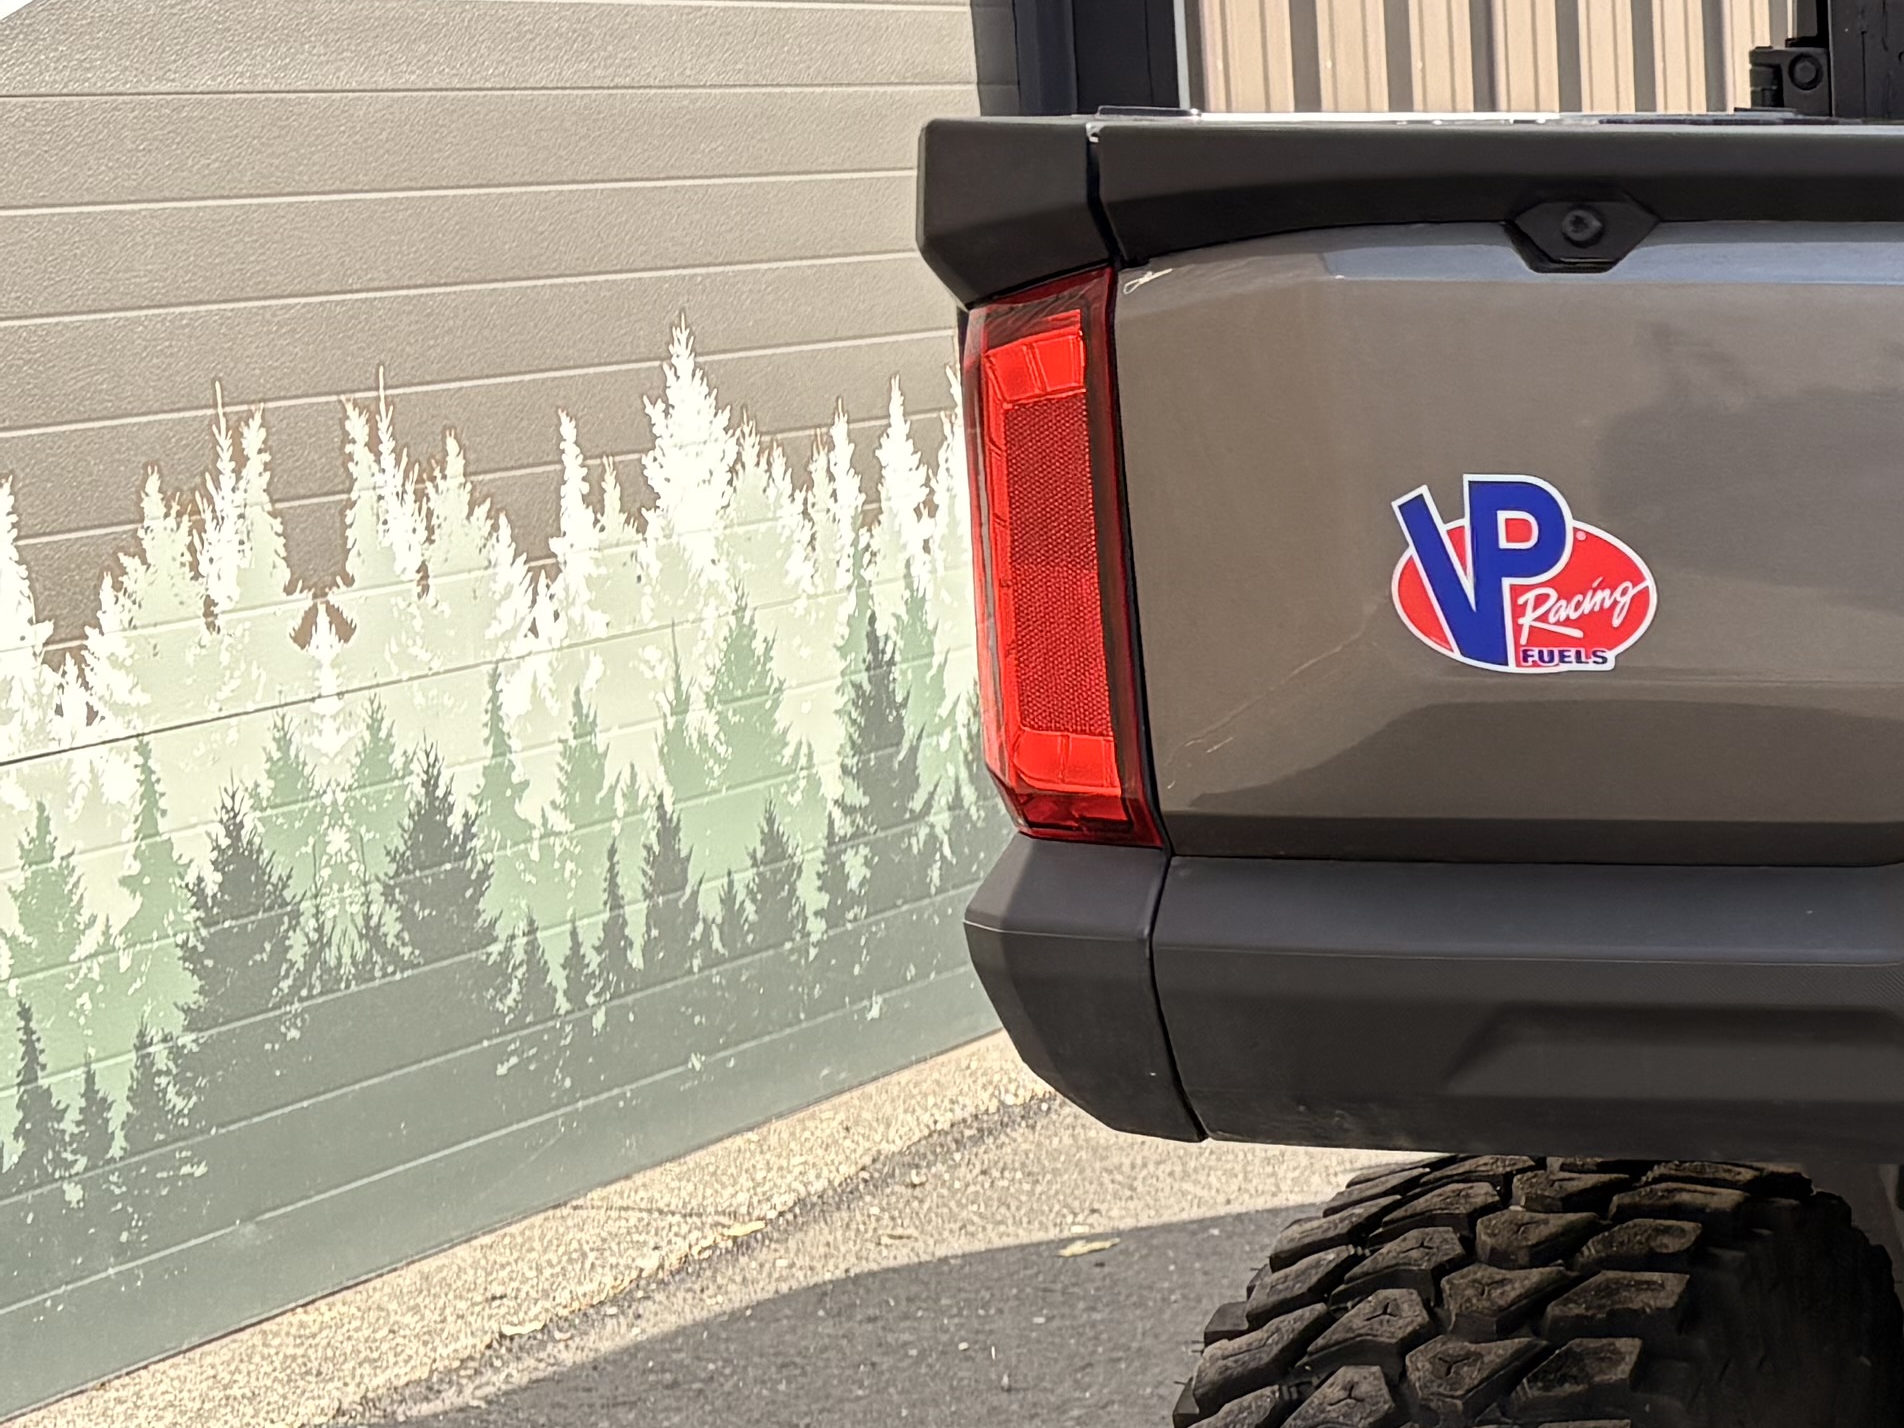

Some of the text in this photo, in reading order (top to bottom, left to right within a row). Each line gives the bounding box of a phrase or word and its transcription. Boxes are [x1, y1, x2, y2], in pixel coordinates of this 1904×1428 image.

[1393, 475, 1571, 668] VP
[1517, 577, 1650, 645] Racing
[1521, 648, 1608, 665] FUELS
